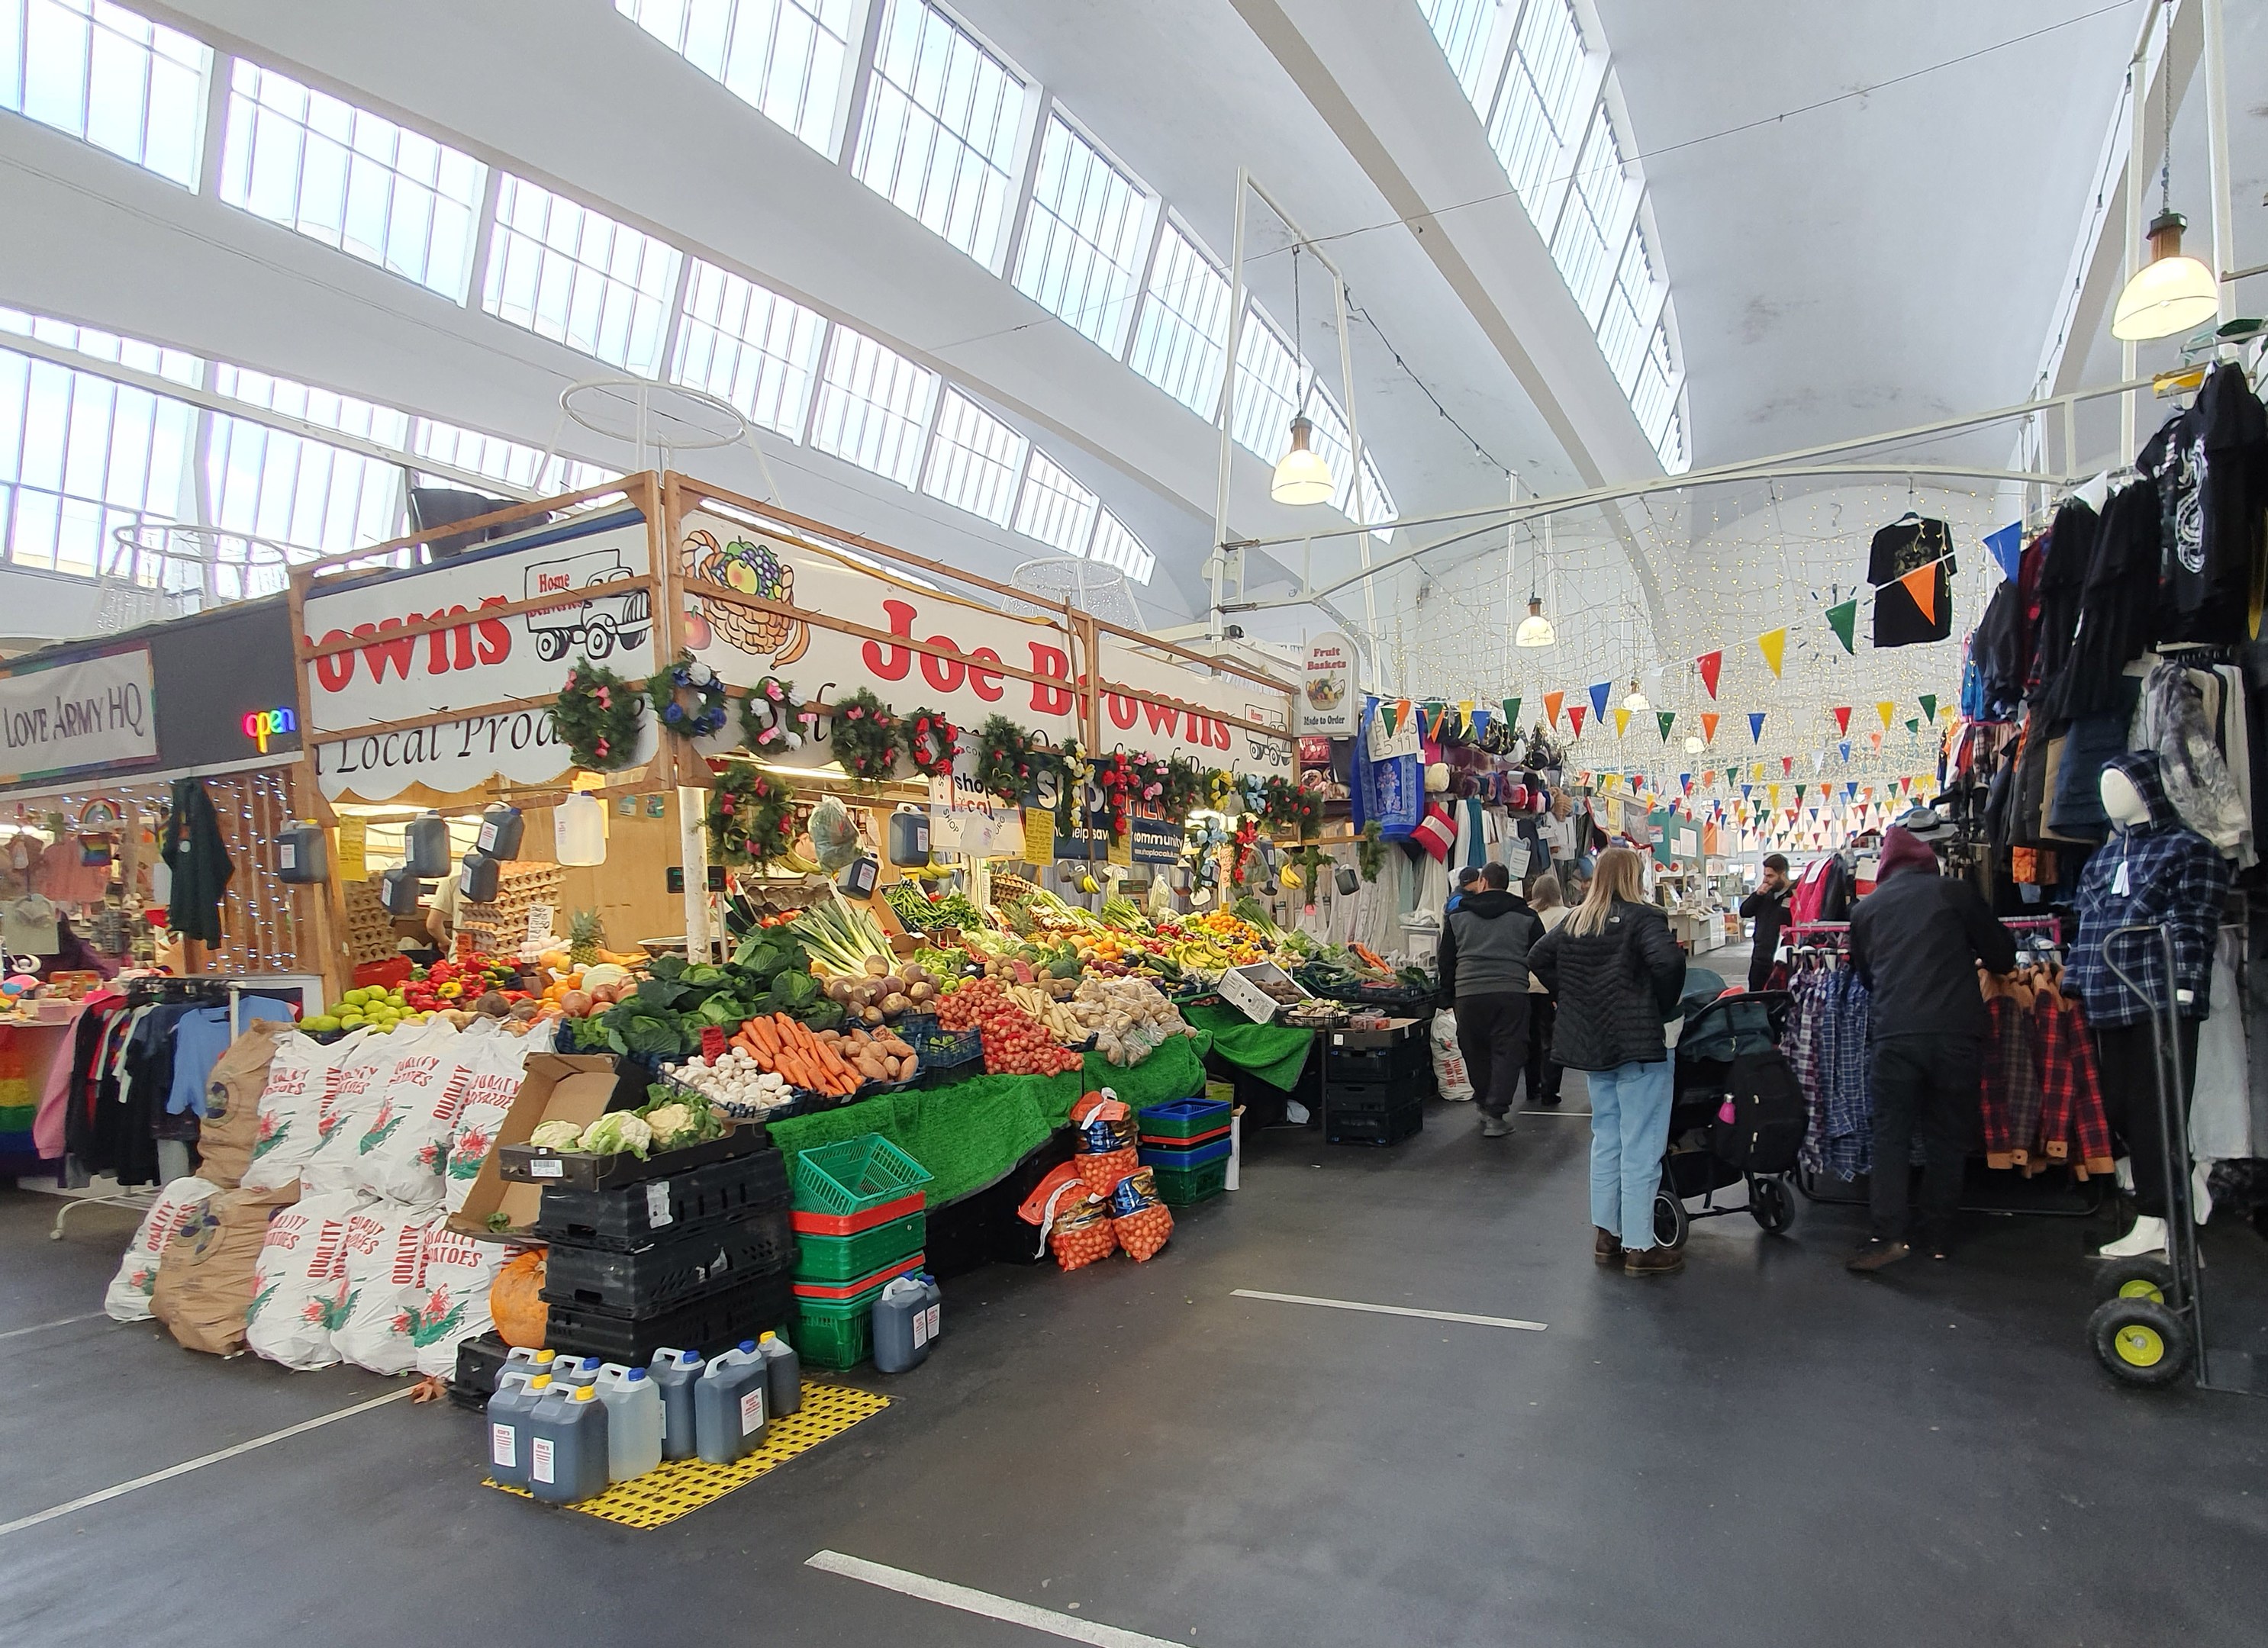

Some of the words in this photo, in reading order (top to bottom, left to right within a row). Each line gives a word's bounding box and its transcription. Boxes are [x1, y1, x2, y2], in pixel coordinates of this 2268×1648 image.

[539, 574, 570, 593] Home
[305, 595, 513, 693] owns
[862, 600, 1004, 702] Joe
[1307, 661, 1347, 671] Baskets
[1313, 648, 1341, 658] Fruit
[4, 707, 48, 748] LOVE
[53, 695, 104, 739] ARMY
[108, 682, 145, 737] HQ
[243, 707, 297, 754] open
[1303, 716, 1319, 726] Made
[1320, 716, 1326, 725] to
[1327, 715, 1345, 725] Order
[337, 725, 441, 773] Local
[1093, 829, 1110, 840] sav
[1133, 832, 1183, 852] community
[395, 1056, 440, 1074] UALITY
[433, 1064, 473, 1121] QUALITY
[147, 1200, 174, 1251] QUALITY
[307, 1219, 343, 1278] QUALITY
[391, 1225, 420, 1285] QUALITY
